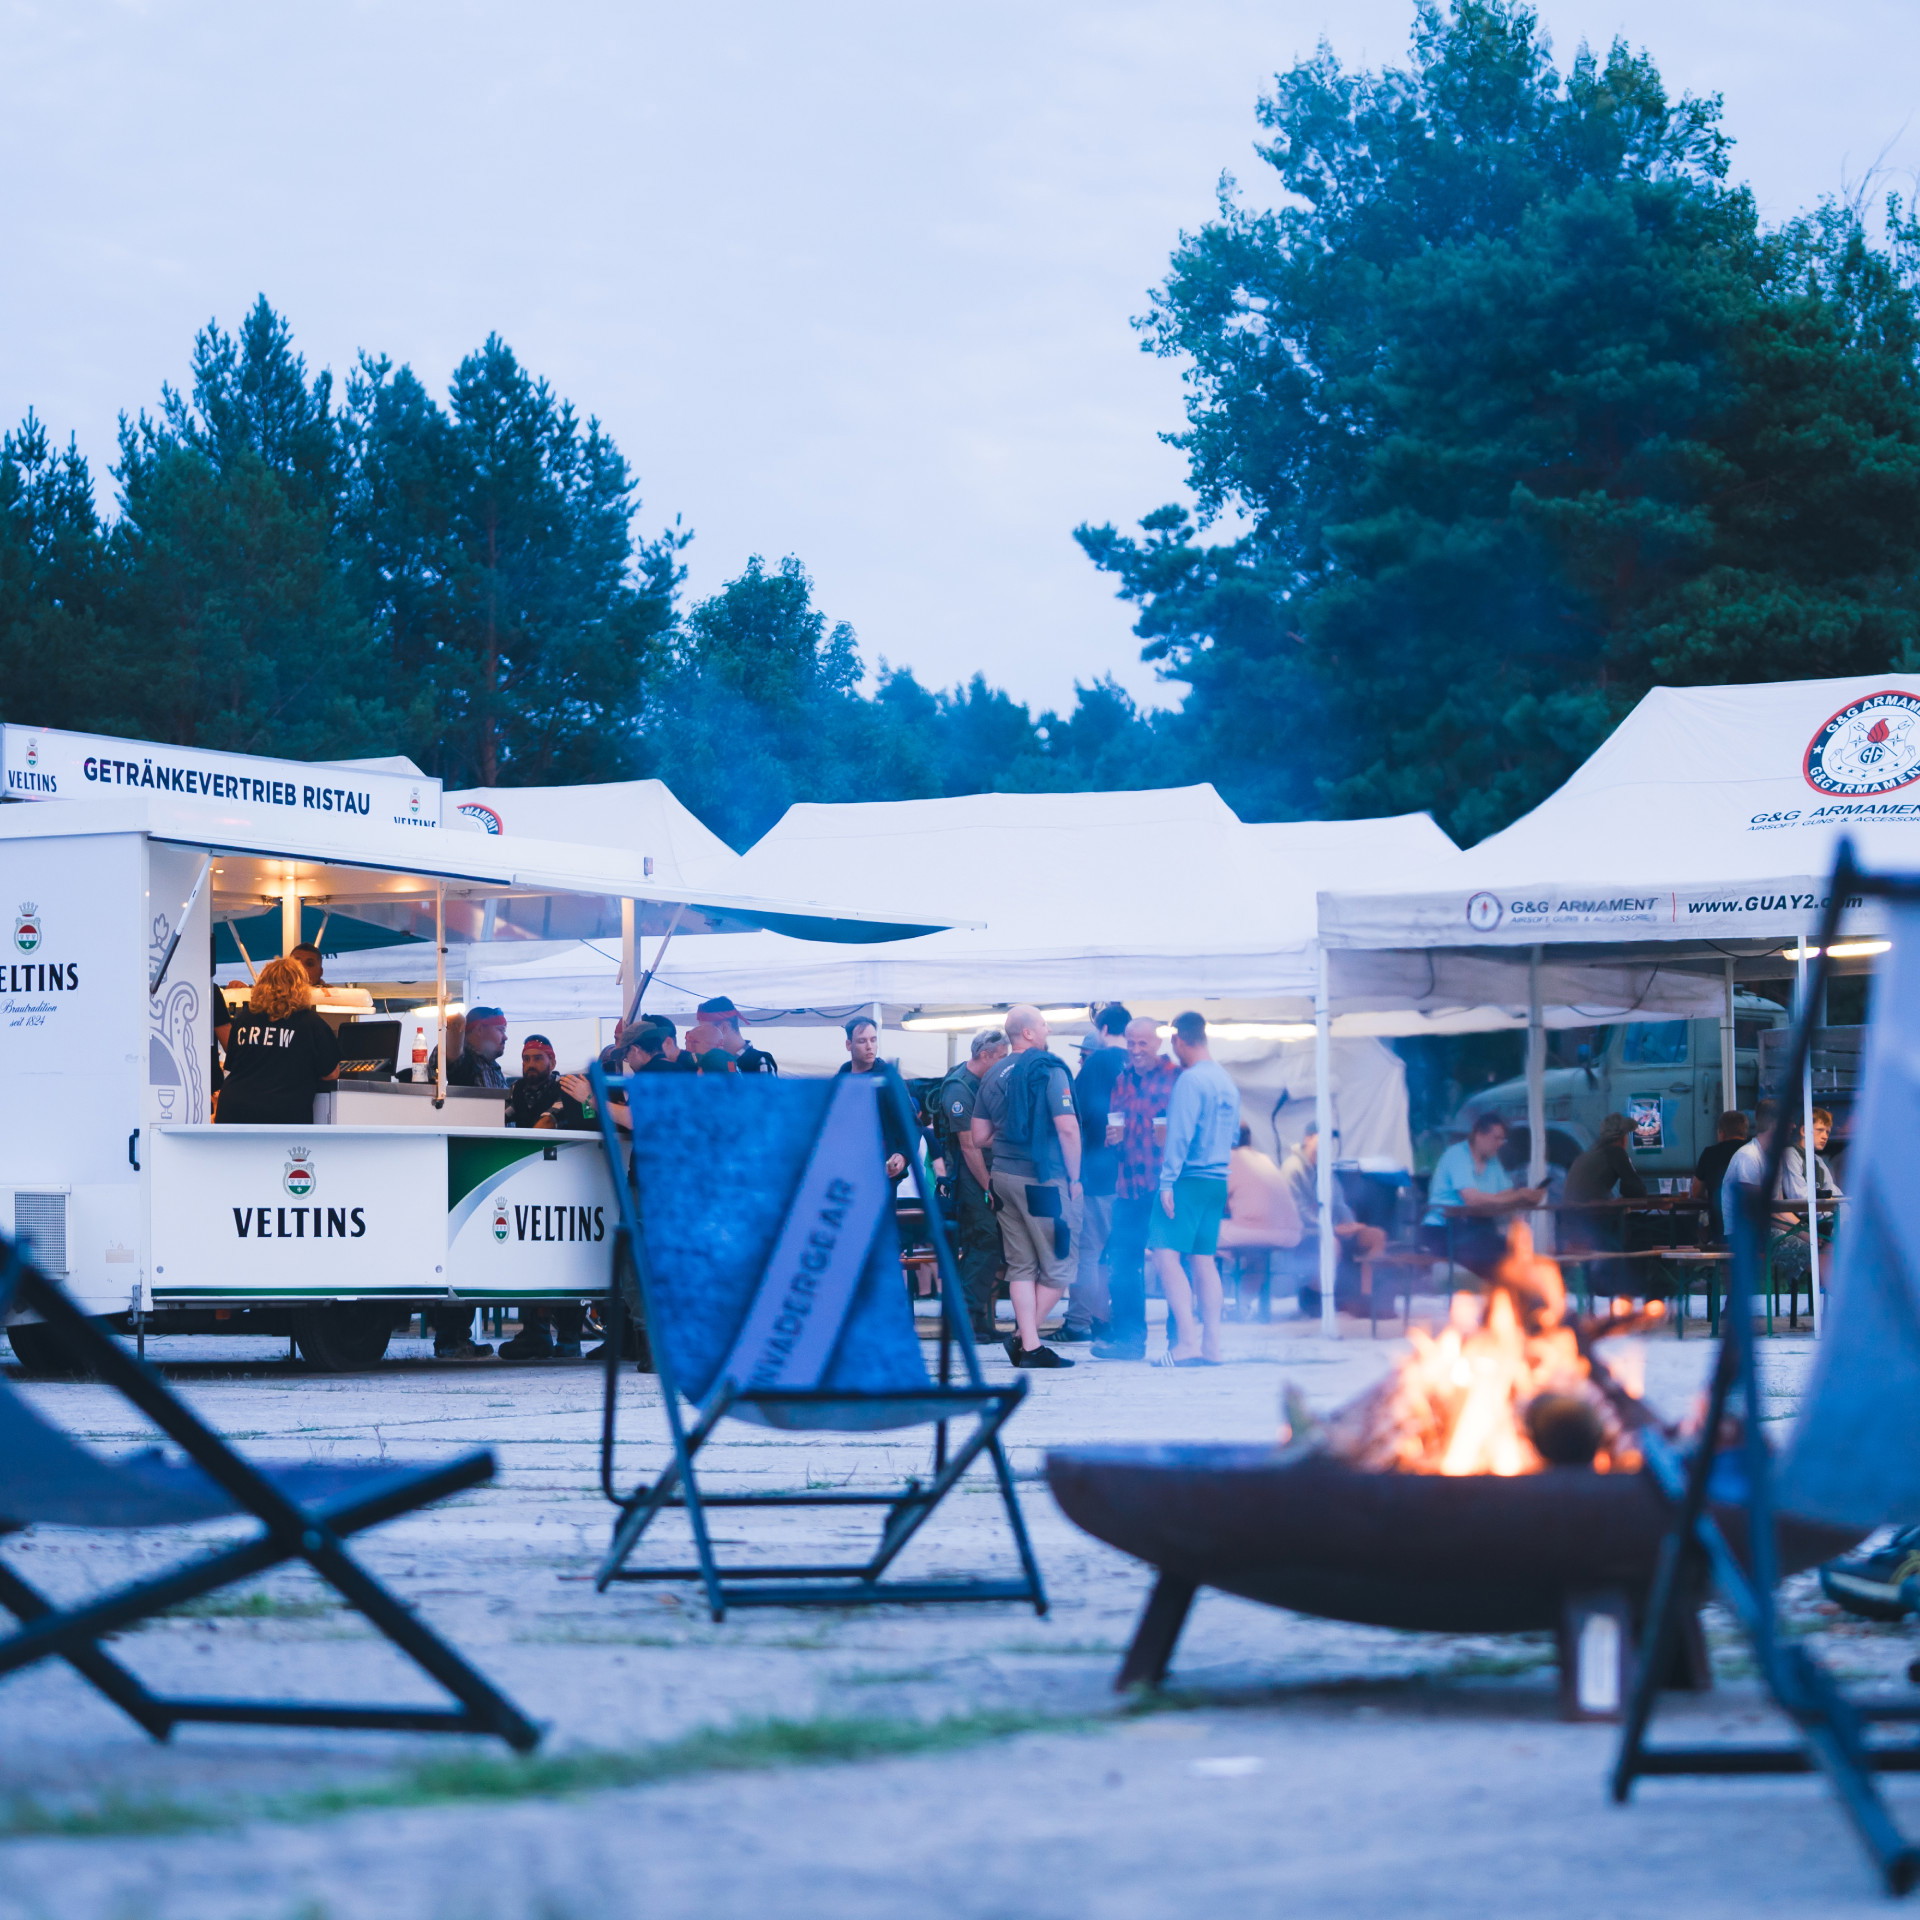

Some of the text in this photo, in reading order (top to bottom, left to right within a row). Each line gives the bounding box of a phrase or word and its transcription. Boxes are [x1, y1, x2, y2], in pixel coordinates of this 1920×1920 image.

[1826, 707, 1859, 733] G&G
[8, 769, 57, 793] VELTINS
[83, 756, 370, 816] GETRÄNKEVERTRIEB RISTAU
[1810, 763, 1920, 794] G&G ARMAMEN
[1746, 822, 1798, 831] AIRSOFT
[1802, 817, 1835, 826] GUNS
[1750, 810, 1801, 824] G&G
[1511, 897, 1660, 914] G&G ARMAMENT
[1688, 894, 1863, 914] www.GUAY2.cm
[0, 998, 57, 1014] Brautradition
[9, 1015, 45, 1027] seit 1824
[237, 1026, 295, 1048] CREW
[232, 1207, 366, 1238] VELTINS
[514, 1205, 605, 1241] VELTINS
